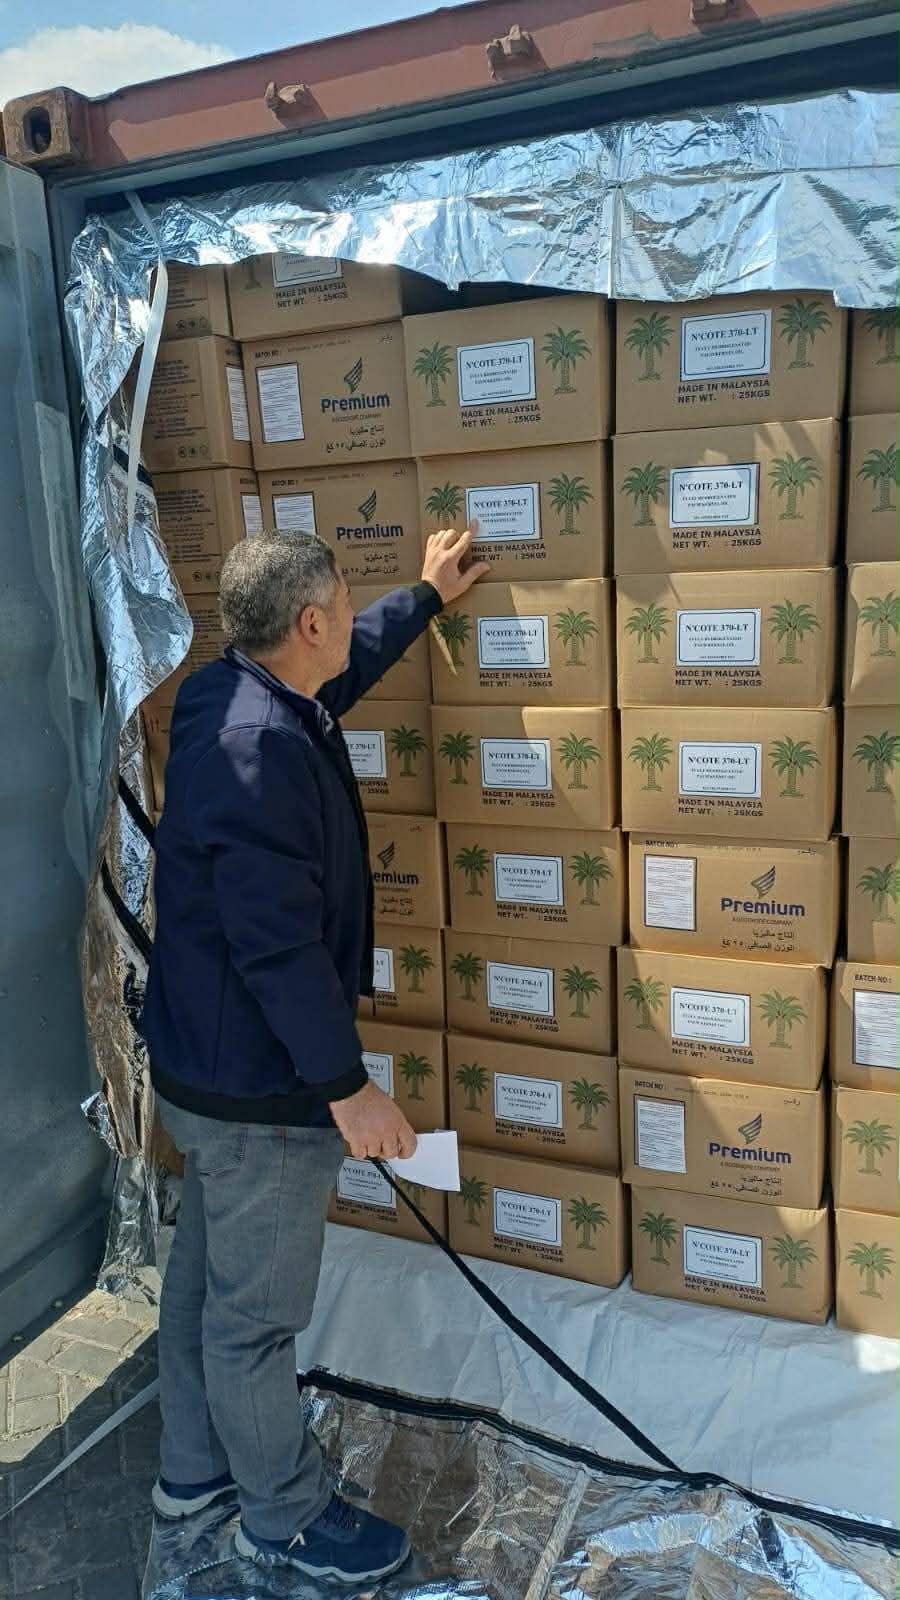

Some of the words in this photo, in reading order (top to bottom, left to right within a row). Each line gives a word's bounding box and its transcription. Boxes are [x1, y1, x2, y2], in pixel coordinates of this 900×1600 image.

[690, 330, 727, 342] N'COTE
[728, 327, 758, 339] 370-LT
[465, 358, 497, 369] N'COTE
[678, 384, 705, 393] MADE
[707, 382, 718, 392] IN
[720, 379, 769, 391] MALAYSIA
[320, 393, 391, 414] Premium
[678, 395, 697, 404] NET
[738, 389, 770, 399] 25KGS
[462, 410, 483, 418] MADE
[486, 408, 496, 417] IN
[497, 404, 541, 414] MALAYSIA
[462, 420, 477, 428] NET
[679, 482, 713, 491] N'COTE
[714, 480, 744, 490] 370-LT
[335, 523, 404, 541] Premium
[672, 531, 698, 540] MADE
[700, 530, 711, 539] IN
[713, 528, 762, 538] MALAYSIA
[672, 541, 690, 549] NET
[731, 538, 763, 547] 25KGS
[685, 624, 719, 633] N'COTE
[720, 623, 749, 632] 370-LT
[674, 670, 701, 678] MADE
[702, 670, 712, 678] IN
[714, 670, 762, 678] MALAYSIA
[675, 679, 693, 687] NET
[731, 679, 762, 688] 25KGS
[687, 756, 719, 765] N'COTE
[721, 756, 750, 765] 370-LT
[677, 799, 703, 807] MADE
[705, 799, 715, 807] IN
[717, 800, 764, 809] MALAYSIA
[678, 807, 695, 815] NET
[734, 809, 764, 817] 25KGS
[373, 870, 419, 885] emium
[720, 896, 806, 917] Premium
[854, 973, 877, 982] BATCH
[679, 1002, 710, 1012] N'COTE
[711, 1006, 738, 1016] 370-LT
[671, 1039, 695, 1049] MADE
[697, 1043, 708, 1051] IN
[709, 1045, 754, 1057] MALAYSIA
[672, 1047, 688, 1056] NET
[725, 1055, 754, 1064] 25KGS
[709, 1141, 793, 1165] Premium
[684, 1276, 708, 1286] MADE
[709, 1280, 720, 1288] IN
[722, 1283, 766, 1297] MALAYSIA
